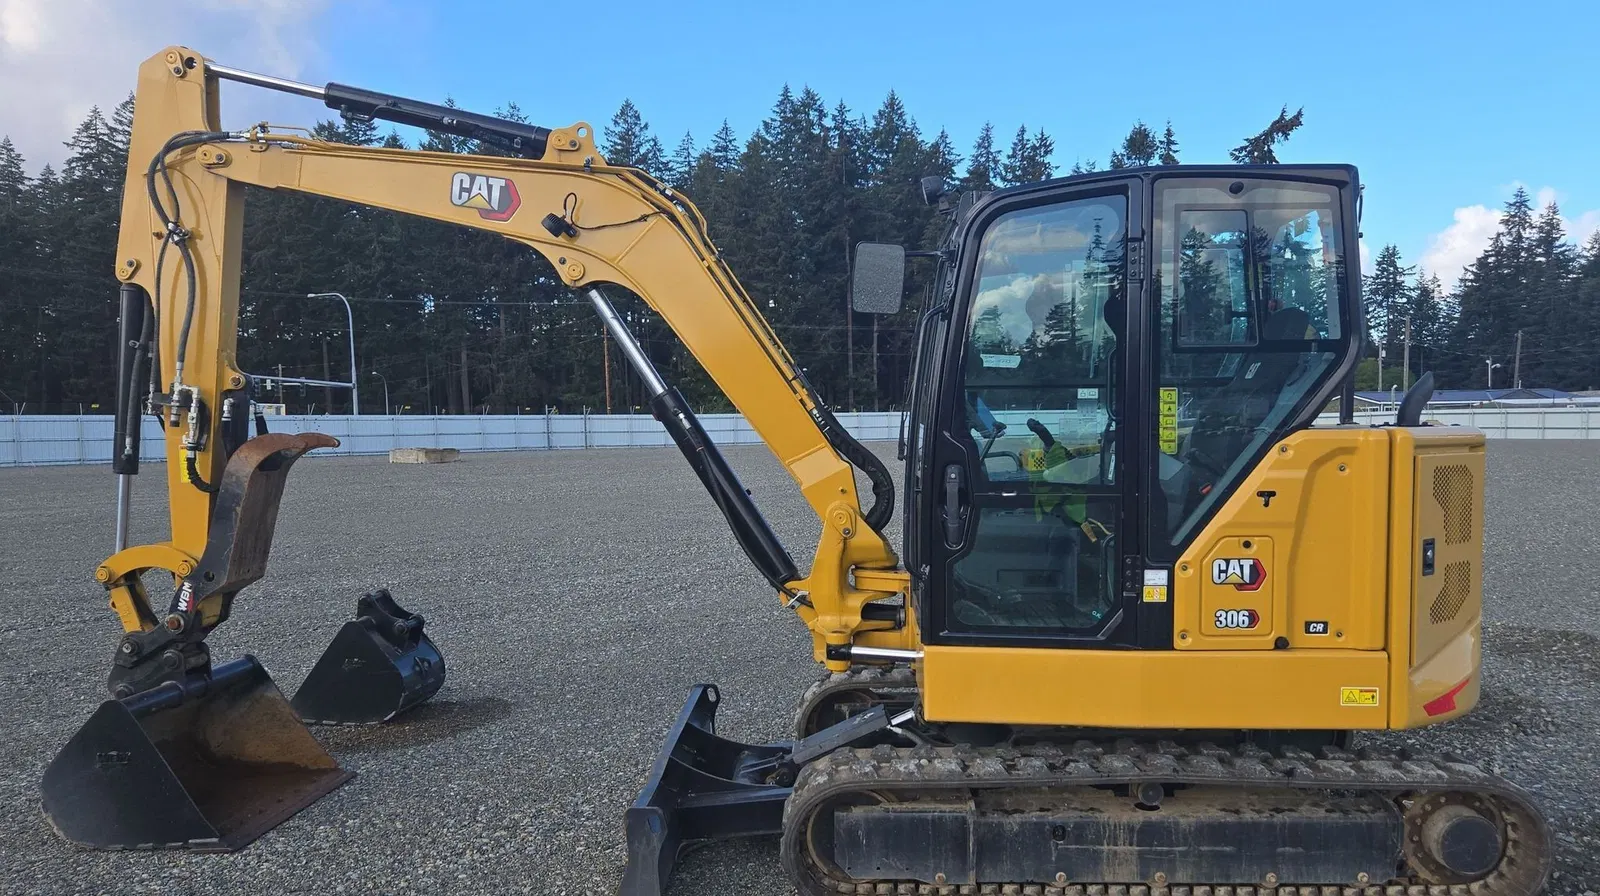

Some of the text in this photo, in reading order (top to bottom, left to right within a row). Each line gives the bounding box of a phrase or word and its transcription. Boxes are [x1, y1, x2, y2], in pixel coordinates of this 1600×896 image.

[451, 173, 506, 211] CAT
[1212, 559, 1254, 584] CAT
[177, 581, 193, 612] WBM
[1215, 610, 1249, 628] 306
[1309, 623, 1325, 633] CR
